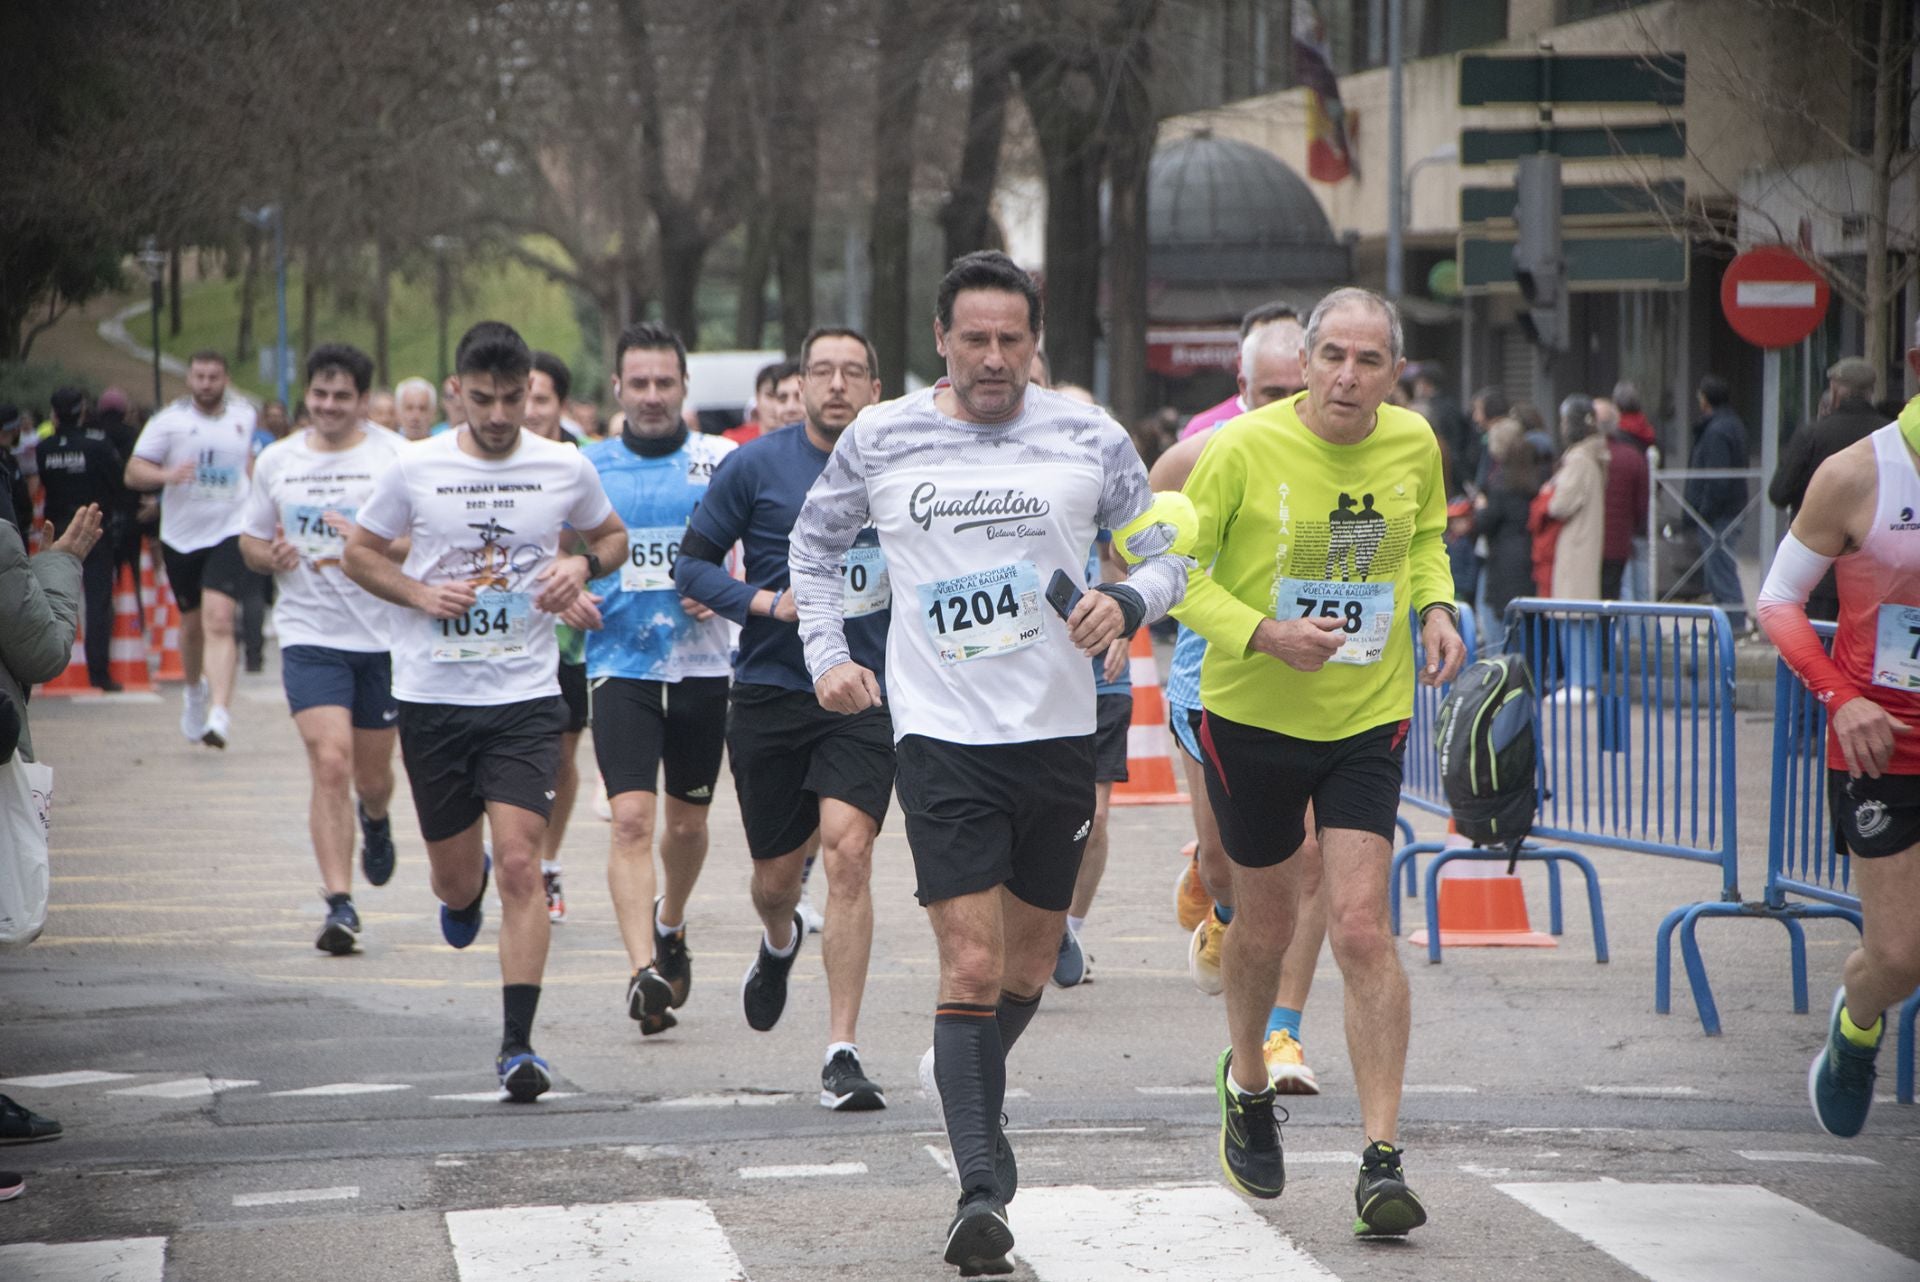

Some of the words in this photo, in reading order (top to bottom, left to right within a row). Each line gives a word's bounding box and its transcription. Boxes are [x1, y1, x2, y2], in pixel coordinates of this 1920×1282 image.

[436, 484, 494, 494] NOVATADAS
[497, 484, 542, 493] MEDICINA
[909, 481, 1050, 531] Guadiatón
[1278, 482, 1290, 536] ATLETA
[986, 525, 1016, 540] Octava
[1017, 524, 1046, 538] Edición
[632, 542, 680, 567] 656
[937, 583, 965, 595] VUELTA
[967, 580, 977, 588] AL
[979, 570, 1018, 585] BALUARTE
[949, 574, 978, 585] CROSS
[980, 565, 1016, 578] POPULAR
[1303, 587, 1331, 595] VUELTA
[929, 584, 1019, 634] 1204
[1296, 598, 1363, 634] 758
[437, 608, 509, 637] 1034
[1020, 627, 1040, 641] HOY
[1366, 648, 1382, 658] HOY
